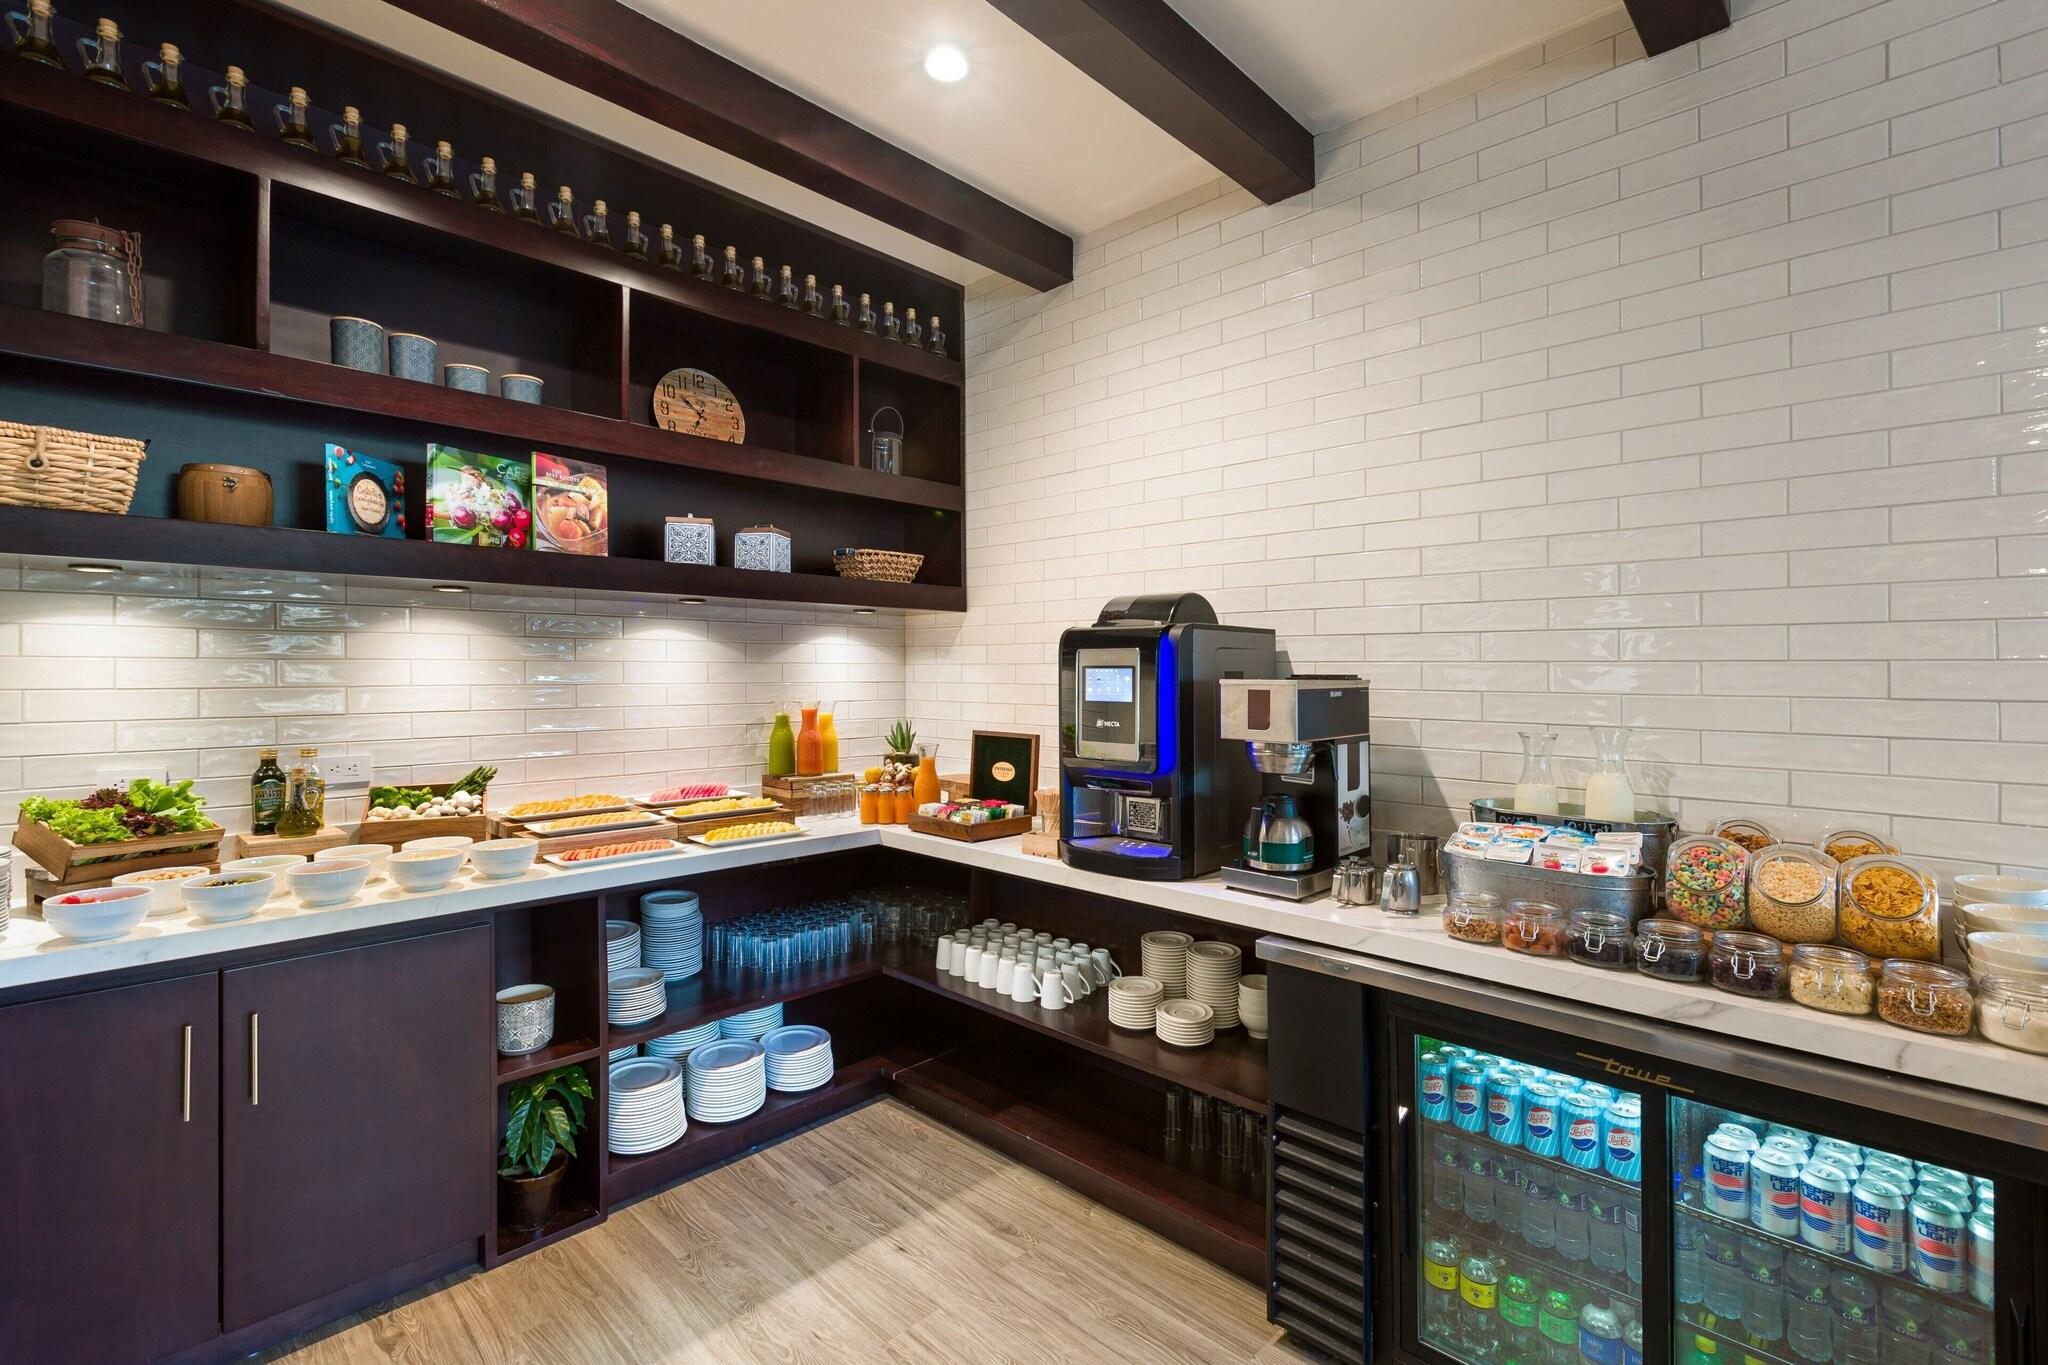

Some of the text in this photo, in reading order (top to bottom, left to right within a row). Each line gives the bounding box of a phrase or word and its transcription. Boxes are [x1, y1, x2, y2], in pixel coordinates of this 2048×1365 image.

[678, 374, 687, 390] 11
[692, 373, 704, 389] 12
[662, 383, 676, 399] 10
[713, 383, 717, 397] 1
[660, 400, 670, 416] 9
[724, 398, 734, 412] 2
[731, 416, 740, 430] 3
[1103, 720, 1121, 728] NECTA
[1604, 1058, 1671, 1083] true
[1711, 1155, 1745, 1170] PEPSI
[1712, 1163, 1744, 1177] LIGHT
[1853, 1194, 1891, 1217] PEPSI
[1855, 1202, 1888, 1224] LIGHT
[1916, 1216, 1958, 1237] PEPSI
[1918, 1226, 1956, 1245] LIGHT
